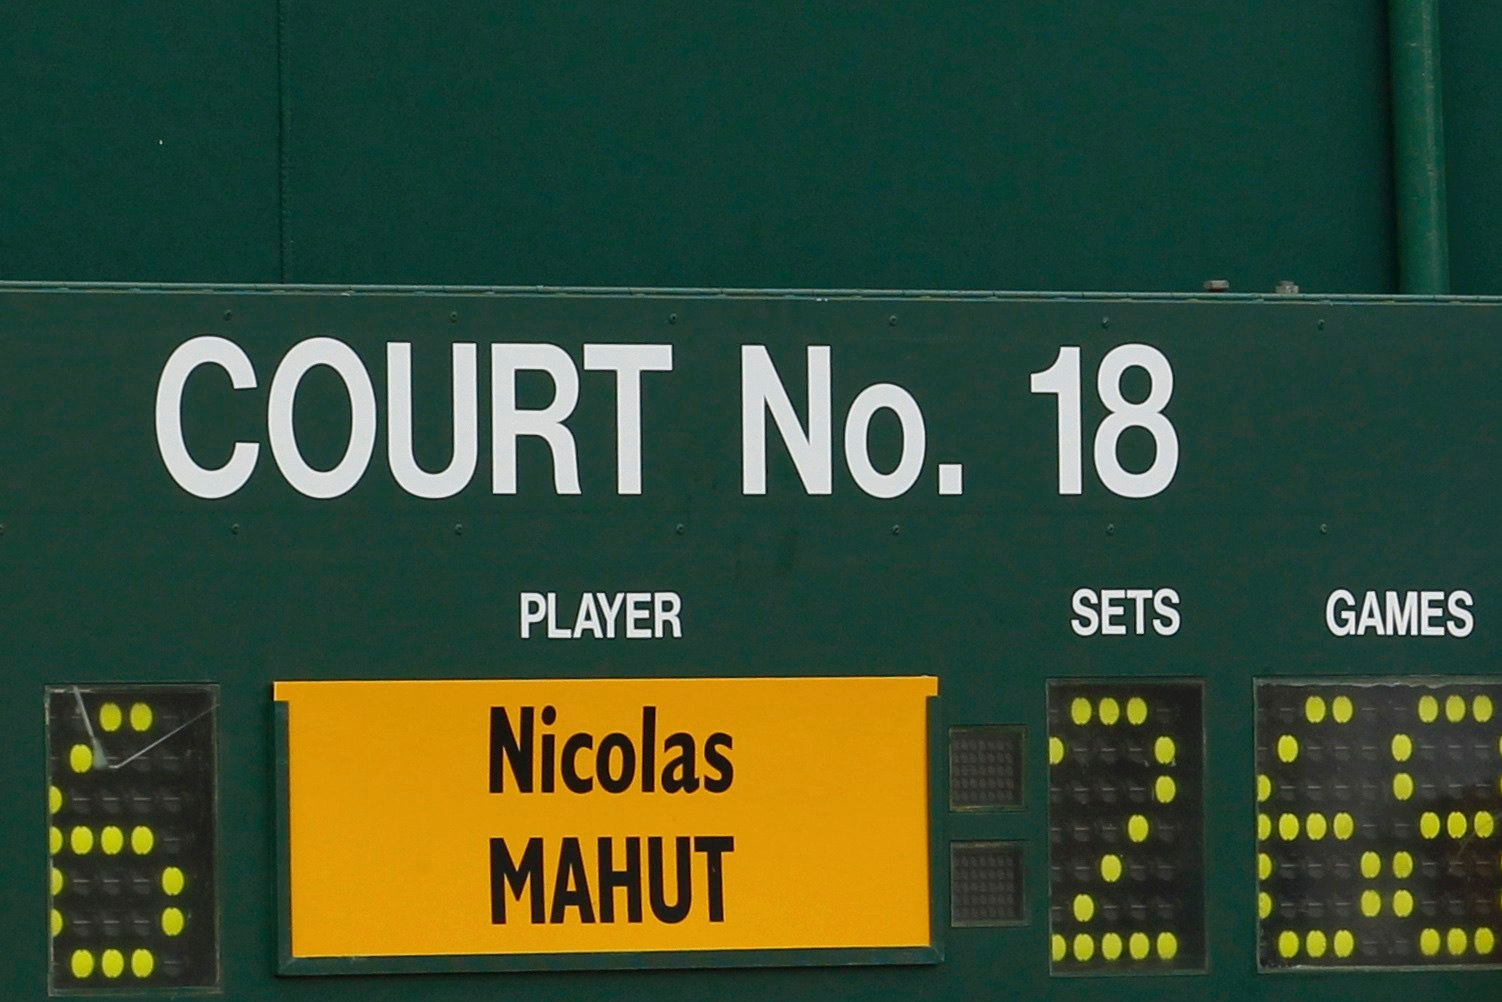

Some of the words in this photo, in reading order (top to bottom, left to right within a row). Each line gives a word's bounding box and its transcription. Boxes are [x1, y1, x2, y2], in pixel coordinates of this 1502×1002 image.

[155, 335, 673, 499] COURT
[741, 344, 963, 499] No.
[1030, 343, 1179, 498] 18
[520, 591, 682, 639] PLAYER
[1071, 588, 1180, 637] SETS
[1325, 589, 1474, 638] GAMES
[489, 705, 734, 794] Nicolas
[49, 704, 184, 978] 6
[1049, 698, 1177, 961] 2
[489, 835, 734, 925] MAHUT
